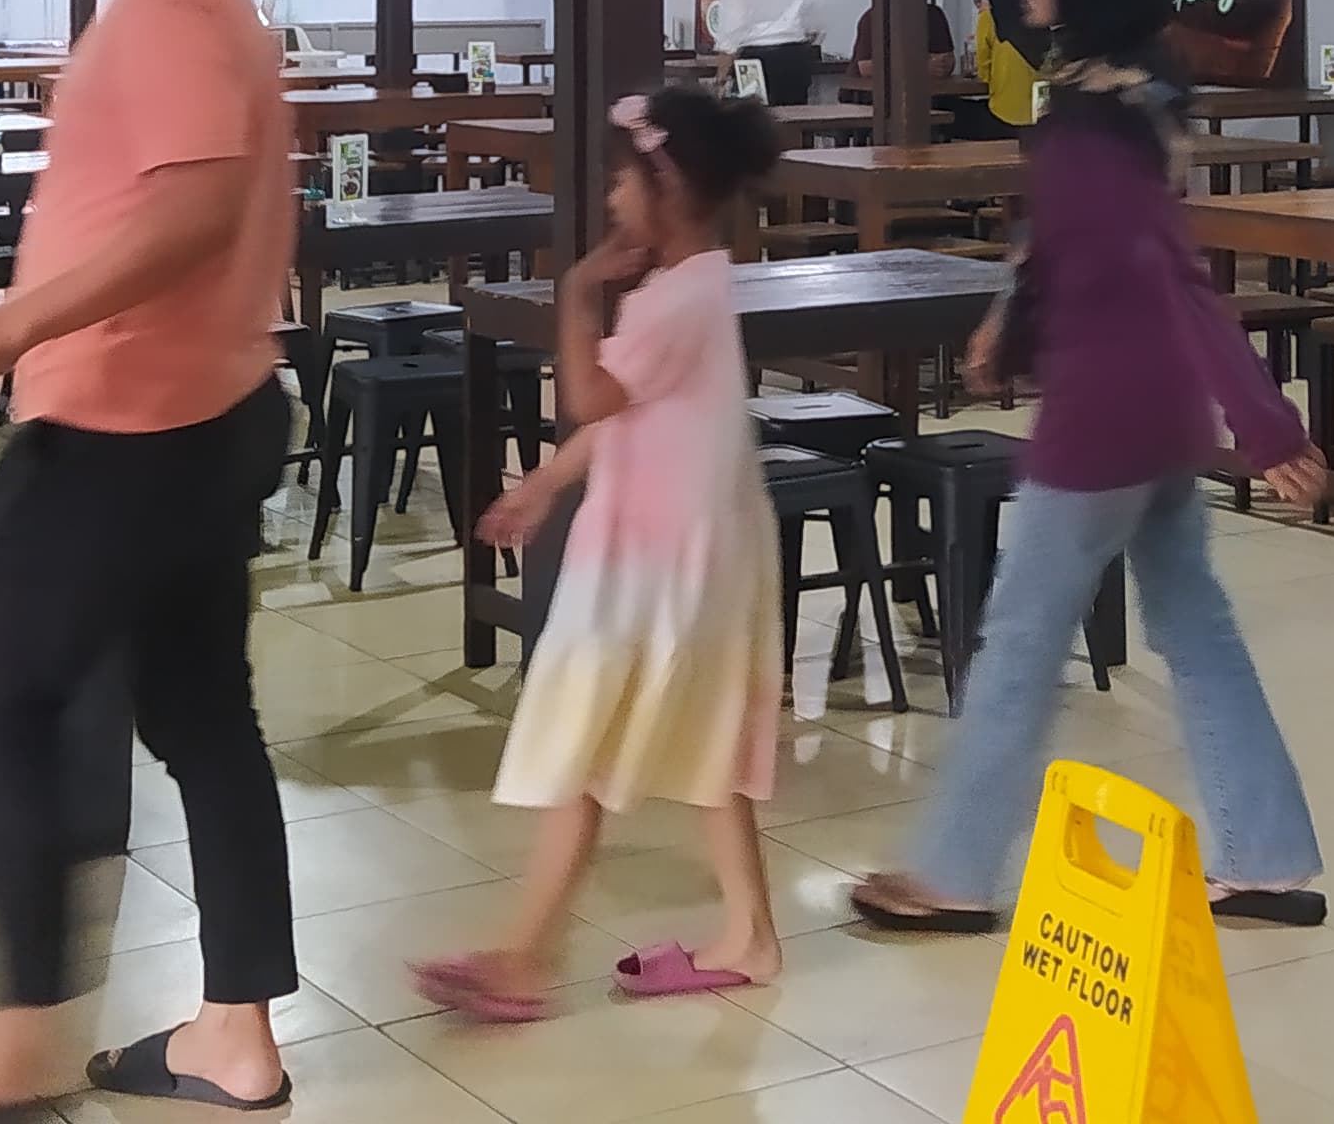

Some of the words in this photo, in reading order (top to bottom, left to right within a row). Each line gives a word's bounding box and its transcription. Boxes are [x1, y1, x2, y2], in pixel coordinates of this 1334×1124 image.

[1022, 941, 1063, 983] WET
[1067, 967, 1134, 1025] FLOOR
[1039, 912, 1130, 982] CAUTION
